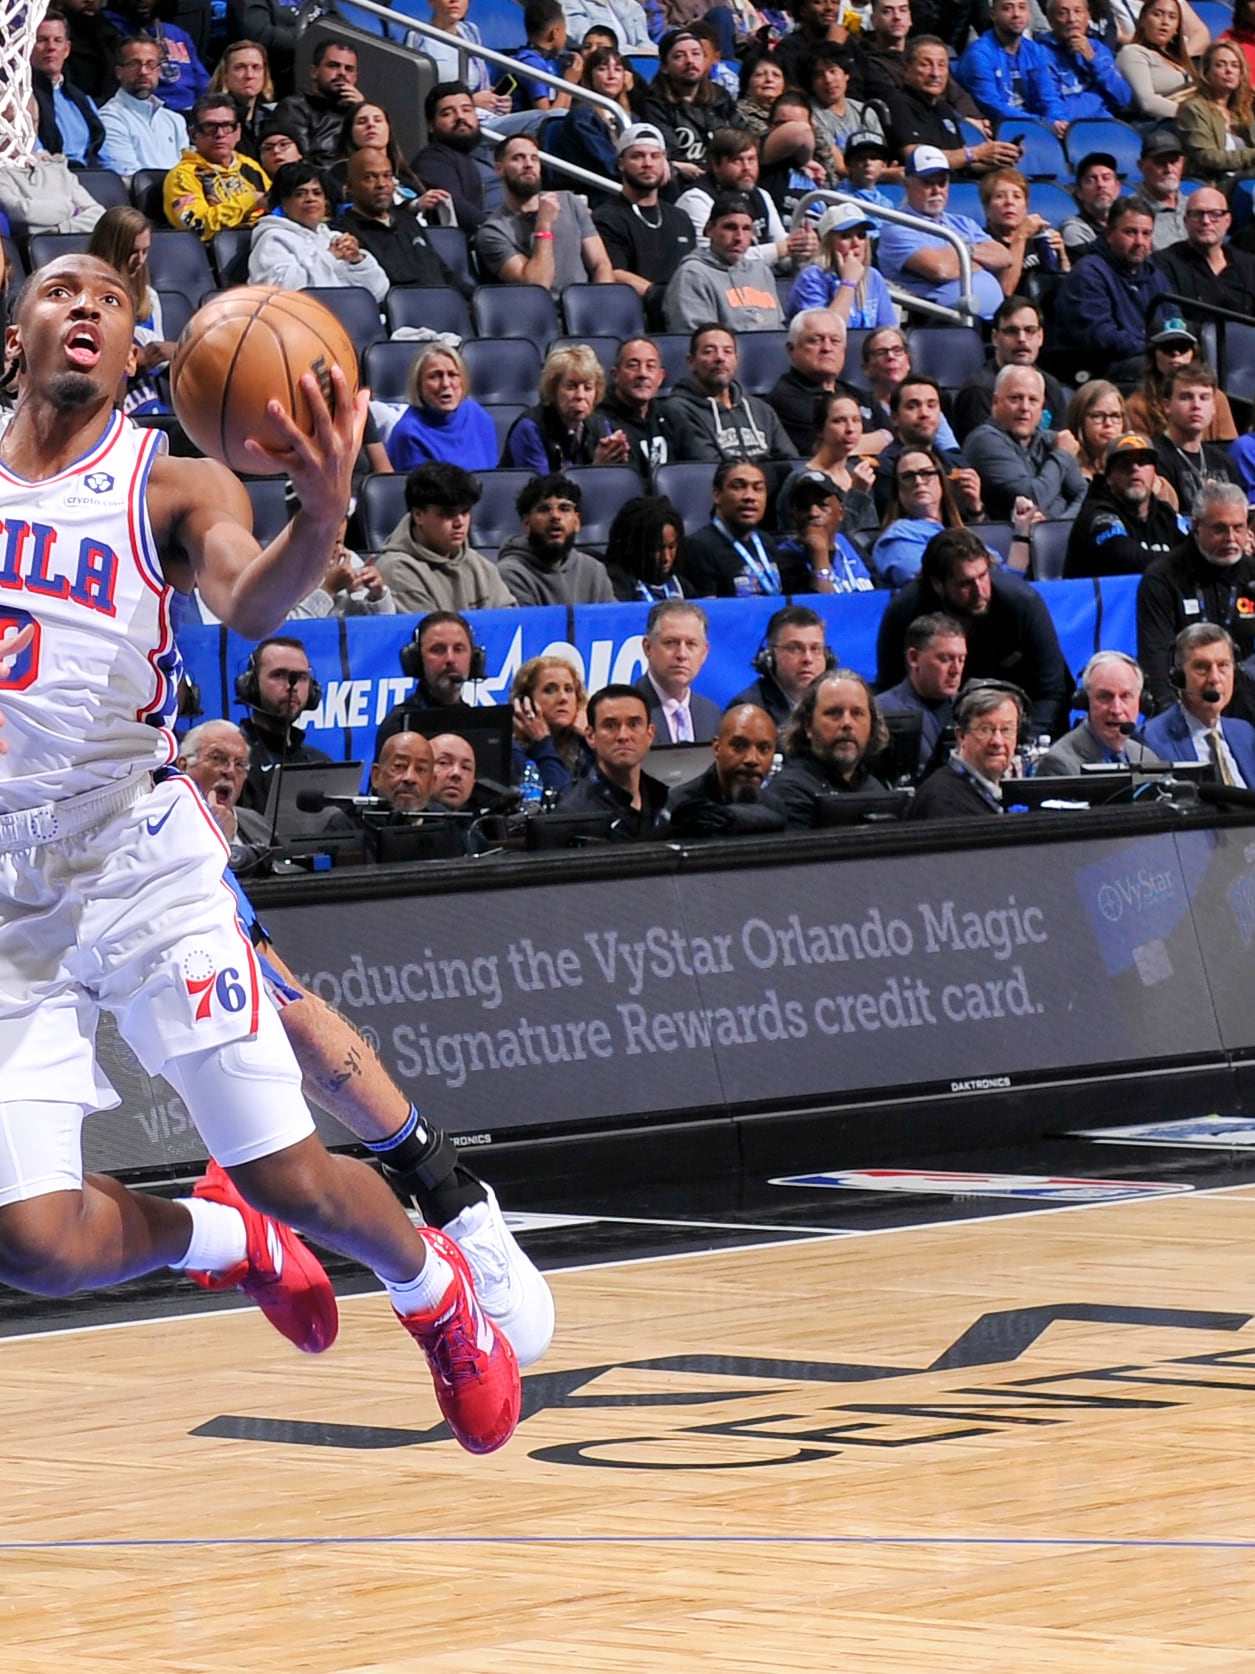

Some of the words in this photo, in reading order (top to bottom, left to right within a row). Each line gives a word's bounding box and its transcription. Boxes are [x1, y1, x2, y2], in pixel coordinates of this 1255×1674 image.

[291, 679, 372, 730] AKE
[507, 939, 583, 991] the
[584, 926, 734, 995] VyStar
[742, 908, 913, 969] Orlando
[918, 896, 1048, 961] Magic
[185, 967, 247, 1023] 76
[393, 1017, 613, 1088] Signature
[616, 990, 808, 1055] Rewards
[815, 976, 936, 1034] credit
[942, 965, 1044, 1022] card.
[951, 1076, 1011, 1092] DAKTRONICS
[133, 1098, 195, 1143] VIS
